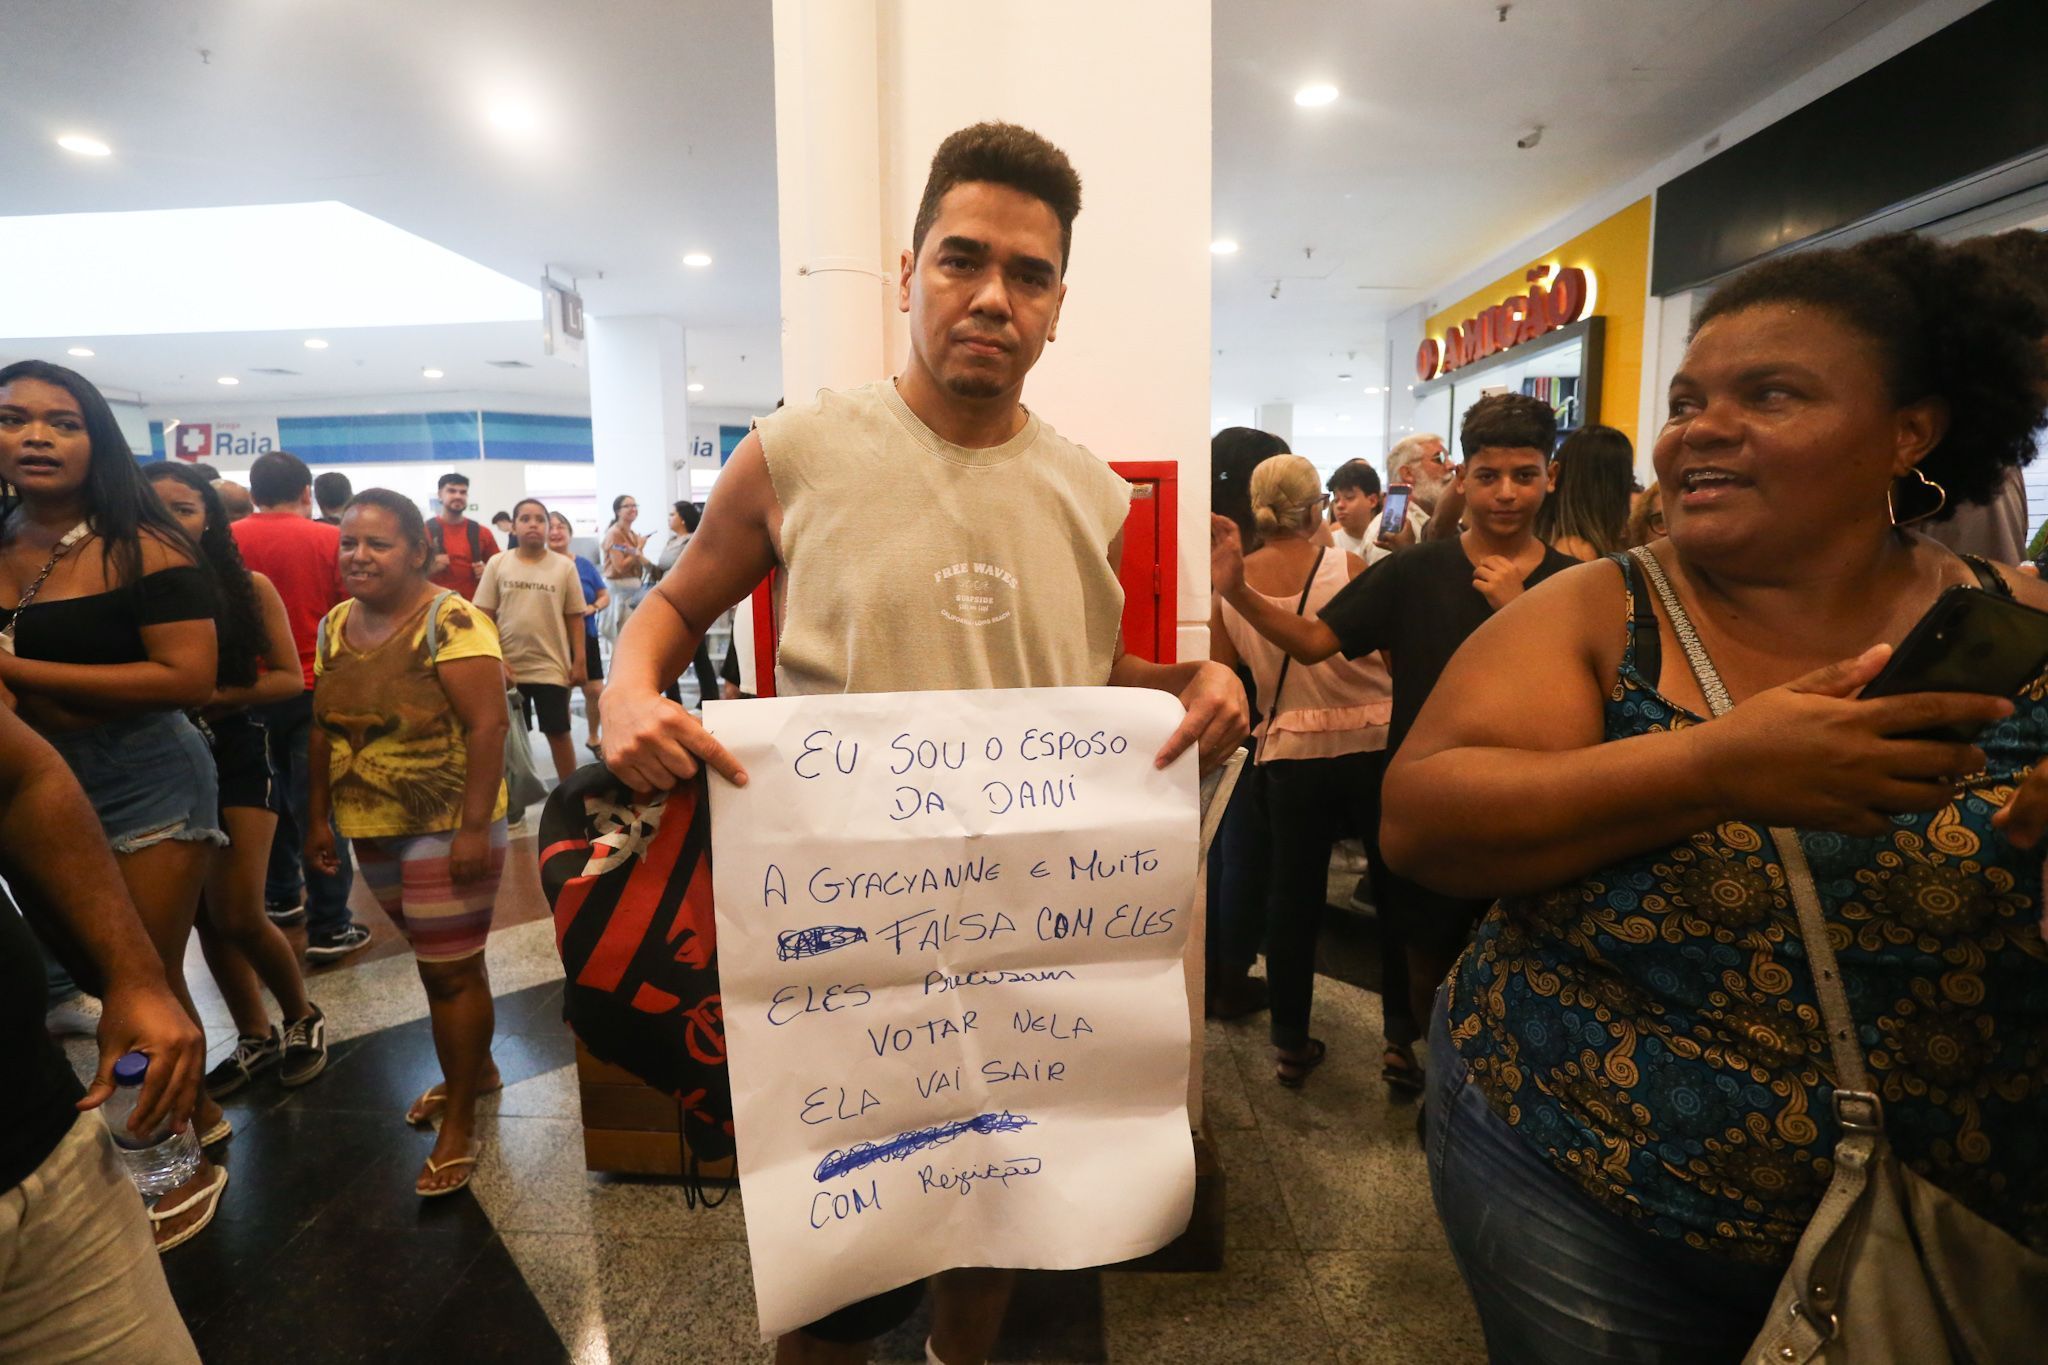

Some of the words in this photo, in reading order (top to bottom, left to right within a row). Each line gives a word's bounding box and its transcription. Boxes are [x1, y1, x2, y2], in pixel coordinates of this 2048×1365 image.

[1417, 338, 1439, 381] O
[215, 432, 272, 456] Raia
[503, 581, 556, 593] ESSENTIALS
[933, 562, 969, 583] FREE
[973, 562, 1019, 590] WAVES
[793, 729, 859, 780] EU
[890, 733, 966, 775] SOU
[985, 736, 1003, 762] O
[1020, 728, 1128, 761] ESPOSO
[889, 785, 945, 821] DA
[764, 863, 788, 908] A
[875, 908, 1017, 956] FALSA
[1104, 903, 1177, 939] ELES
[767, 983, 872, 1026] ELES
[867, 1010, 979, 1057] VOTAR
[1013, 1008, 1095, 1040] NELA
[799, 1086, 881, 1125] ELA
[810, 1179, 883, 1230] COM
